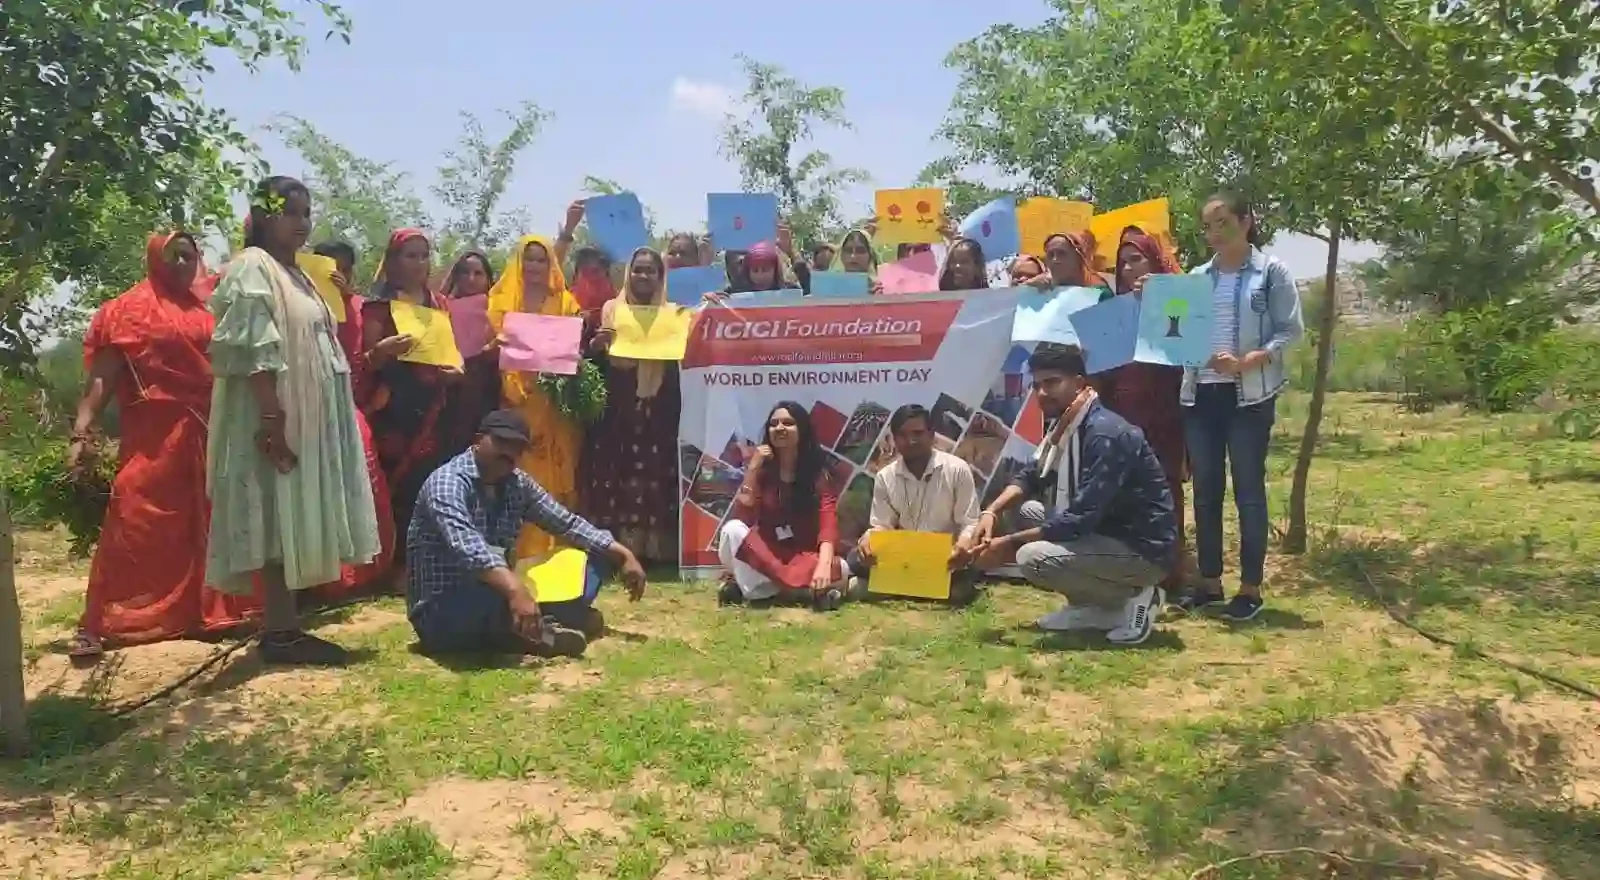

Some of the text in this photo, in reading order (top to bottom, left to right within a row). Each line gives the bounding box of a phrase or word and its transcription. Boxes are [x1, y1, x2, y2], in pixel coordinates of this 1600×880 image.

[714, 316, 922, 339] ICICI Foundation
[703, 368, 932, 387] WORLD ENVIRONMENT DAY
